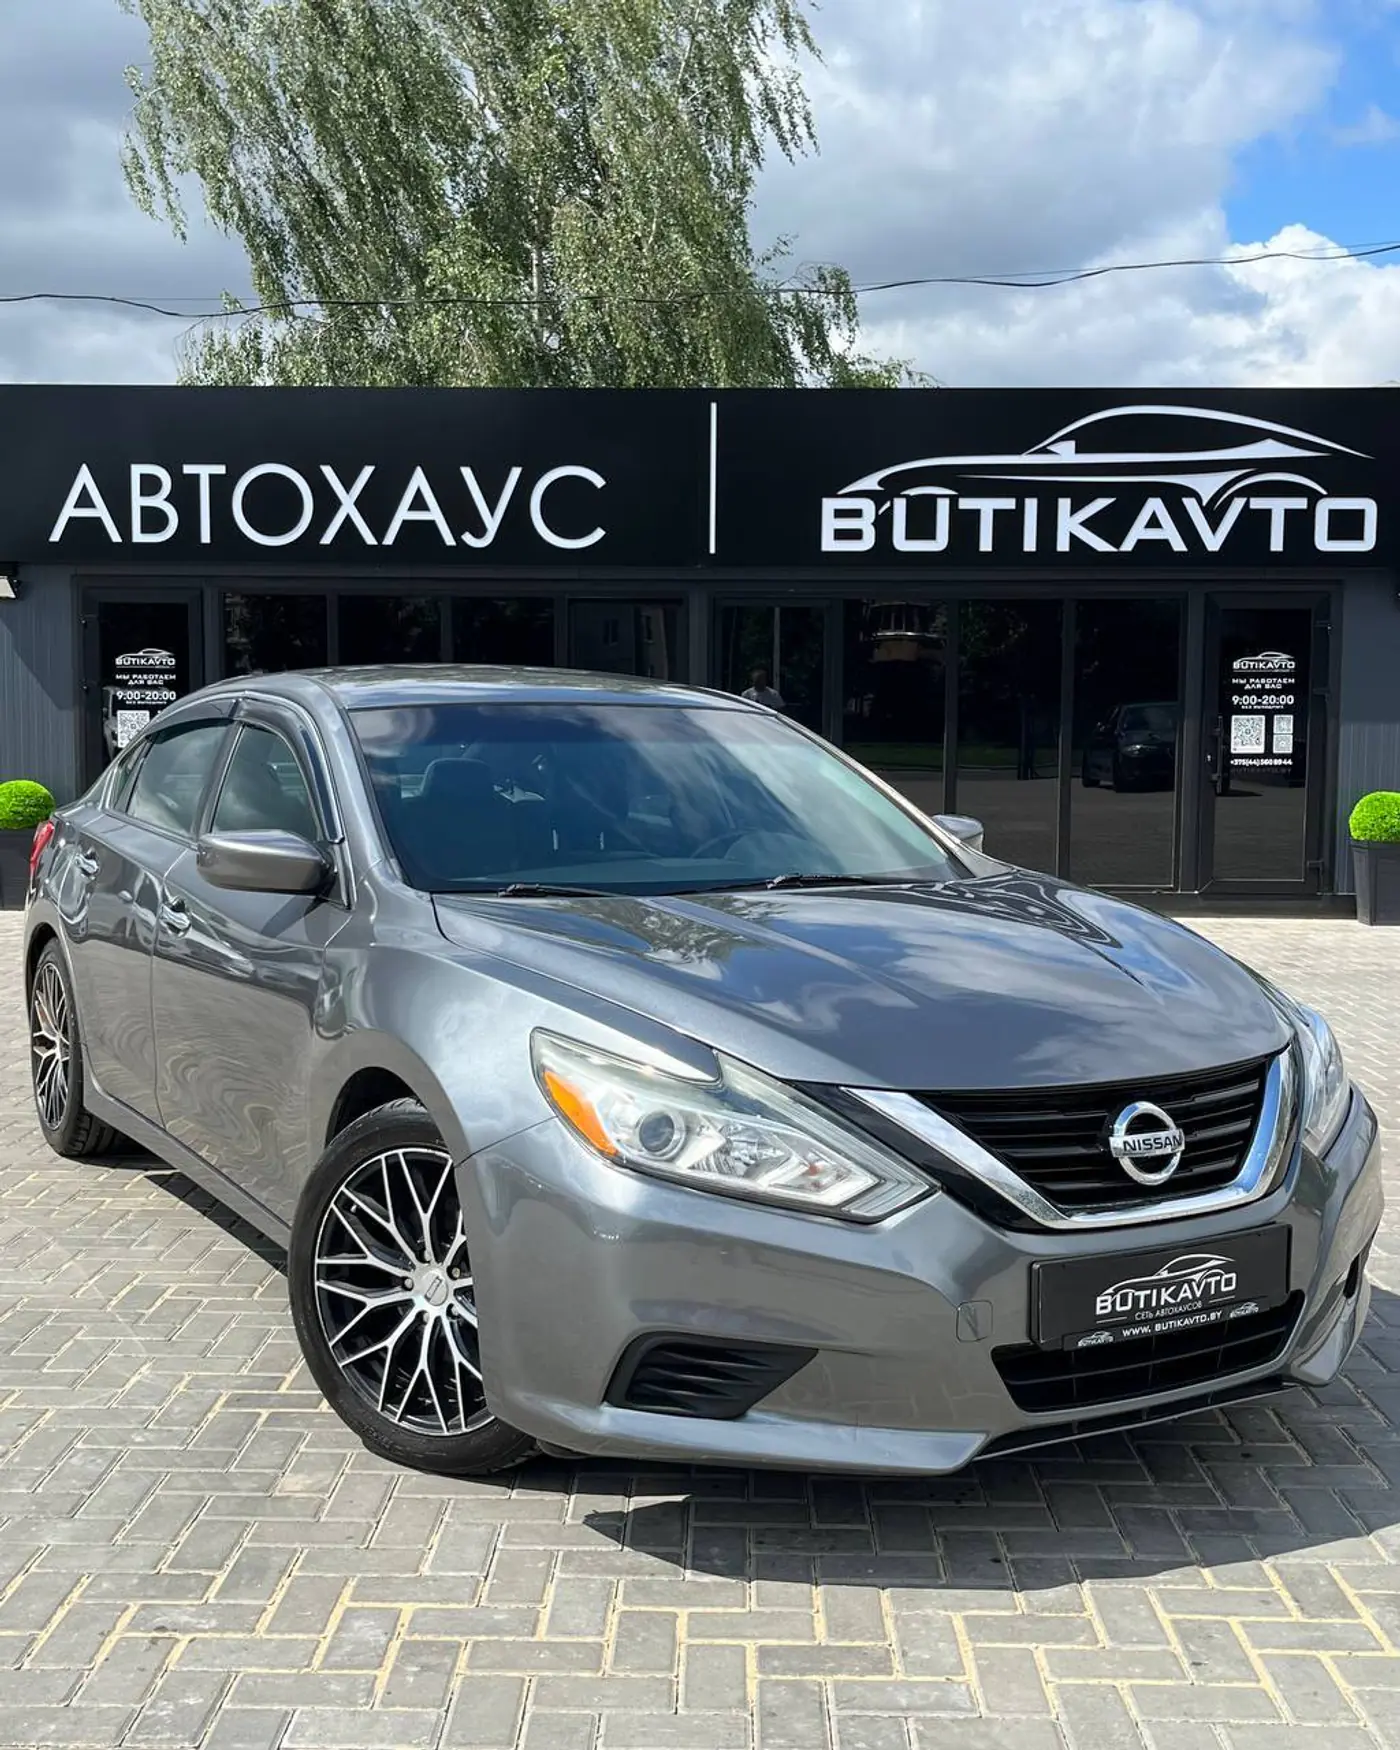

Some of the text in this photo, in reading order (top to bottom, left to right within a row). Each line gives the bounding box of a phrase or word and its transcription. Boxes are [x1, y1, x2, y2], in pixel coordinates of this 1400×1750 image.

[49, 462, 608, 549] АВТОХАУС
[820, 495, 1378, 553] BUTIKAVTO
[115, 657, 176, 666] BUTIKAVTO
[1232, 661, 1296, 670] BUTIKAVTO
[116, 691, 177, 700] 9:00-20:00
[1231, 695, 1295, 705] 9:00-20:00
[1123, 1134, 1183, 1153] NISSAN
[1095, 1272, 1237, 1315] BUTIKAVTO
[1155, 1301, 1203, 1318] АВТОХАУСОВ
[1122, 1310, 1223, 1338] WWW. BUTIKAVTO.BY
